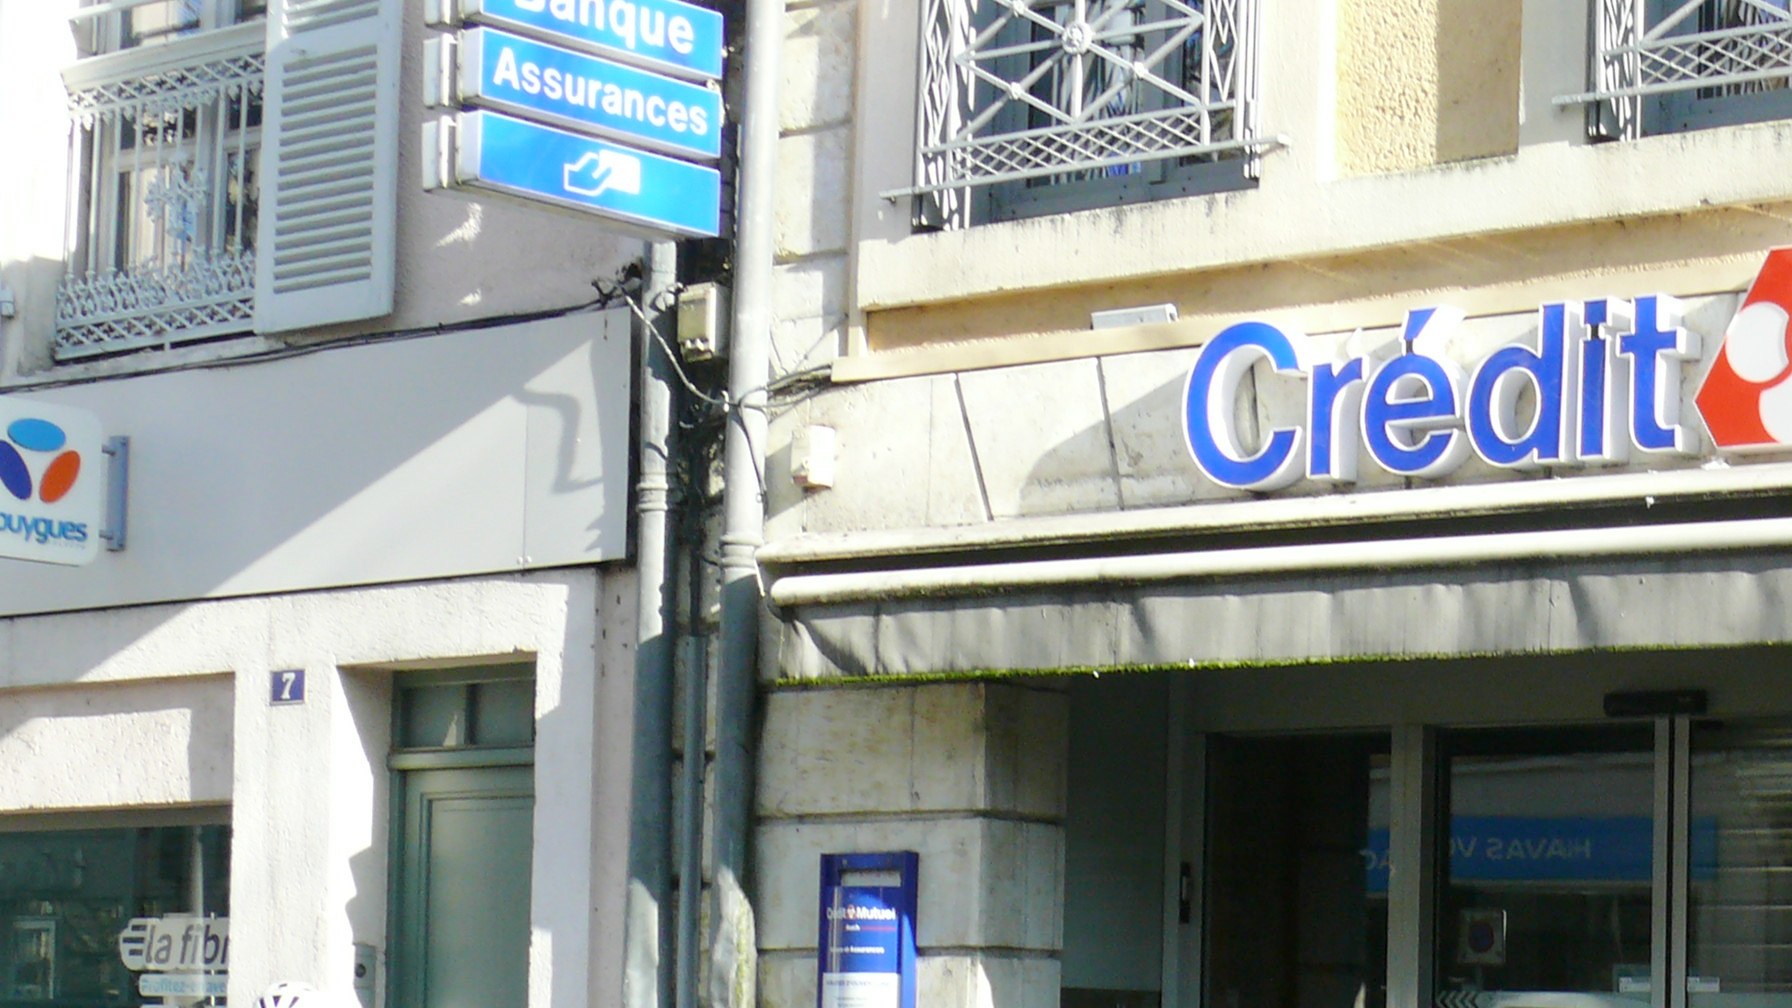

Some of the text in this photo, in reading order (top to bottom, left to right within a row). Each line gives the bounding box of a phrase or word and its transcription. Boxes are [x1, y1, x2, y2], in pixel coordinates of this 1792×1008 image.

[493, 47, 709, 136] Assurances
[1182, 295, 1682, 491] Crédit
[281, 672, 296, 700] 7
[144, 922, 173, 966] la
